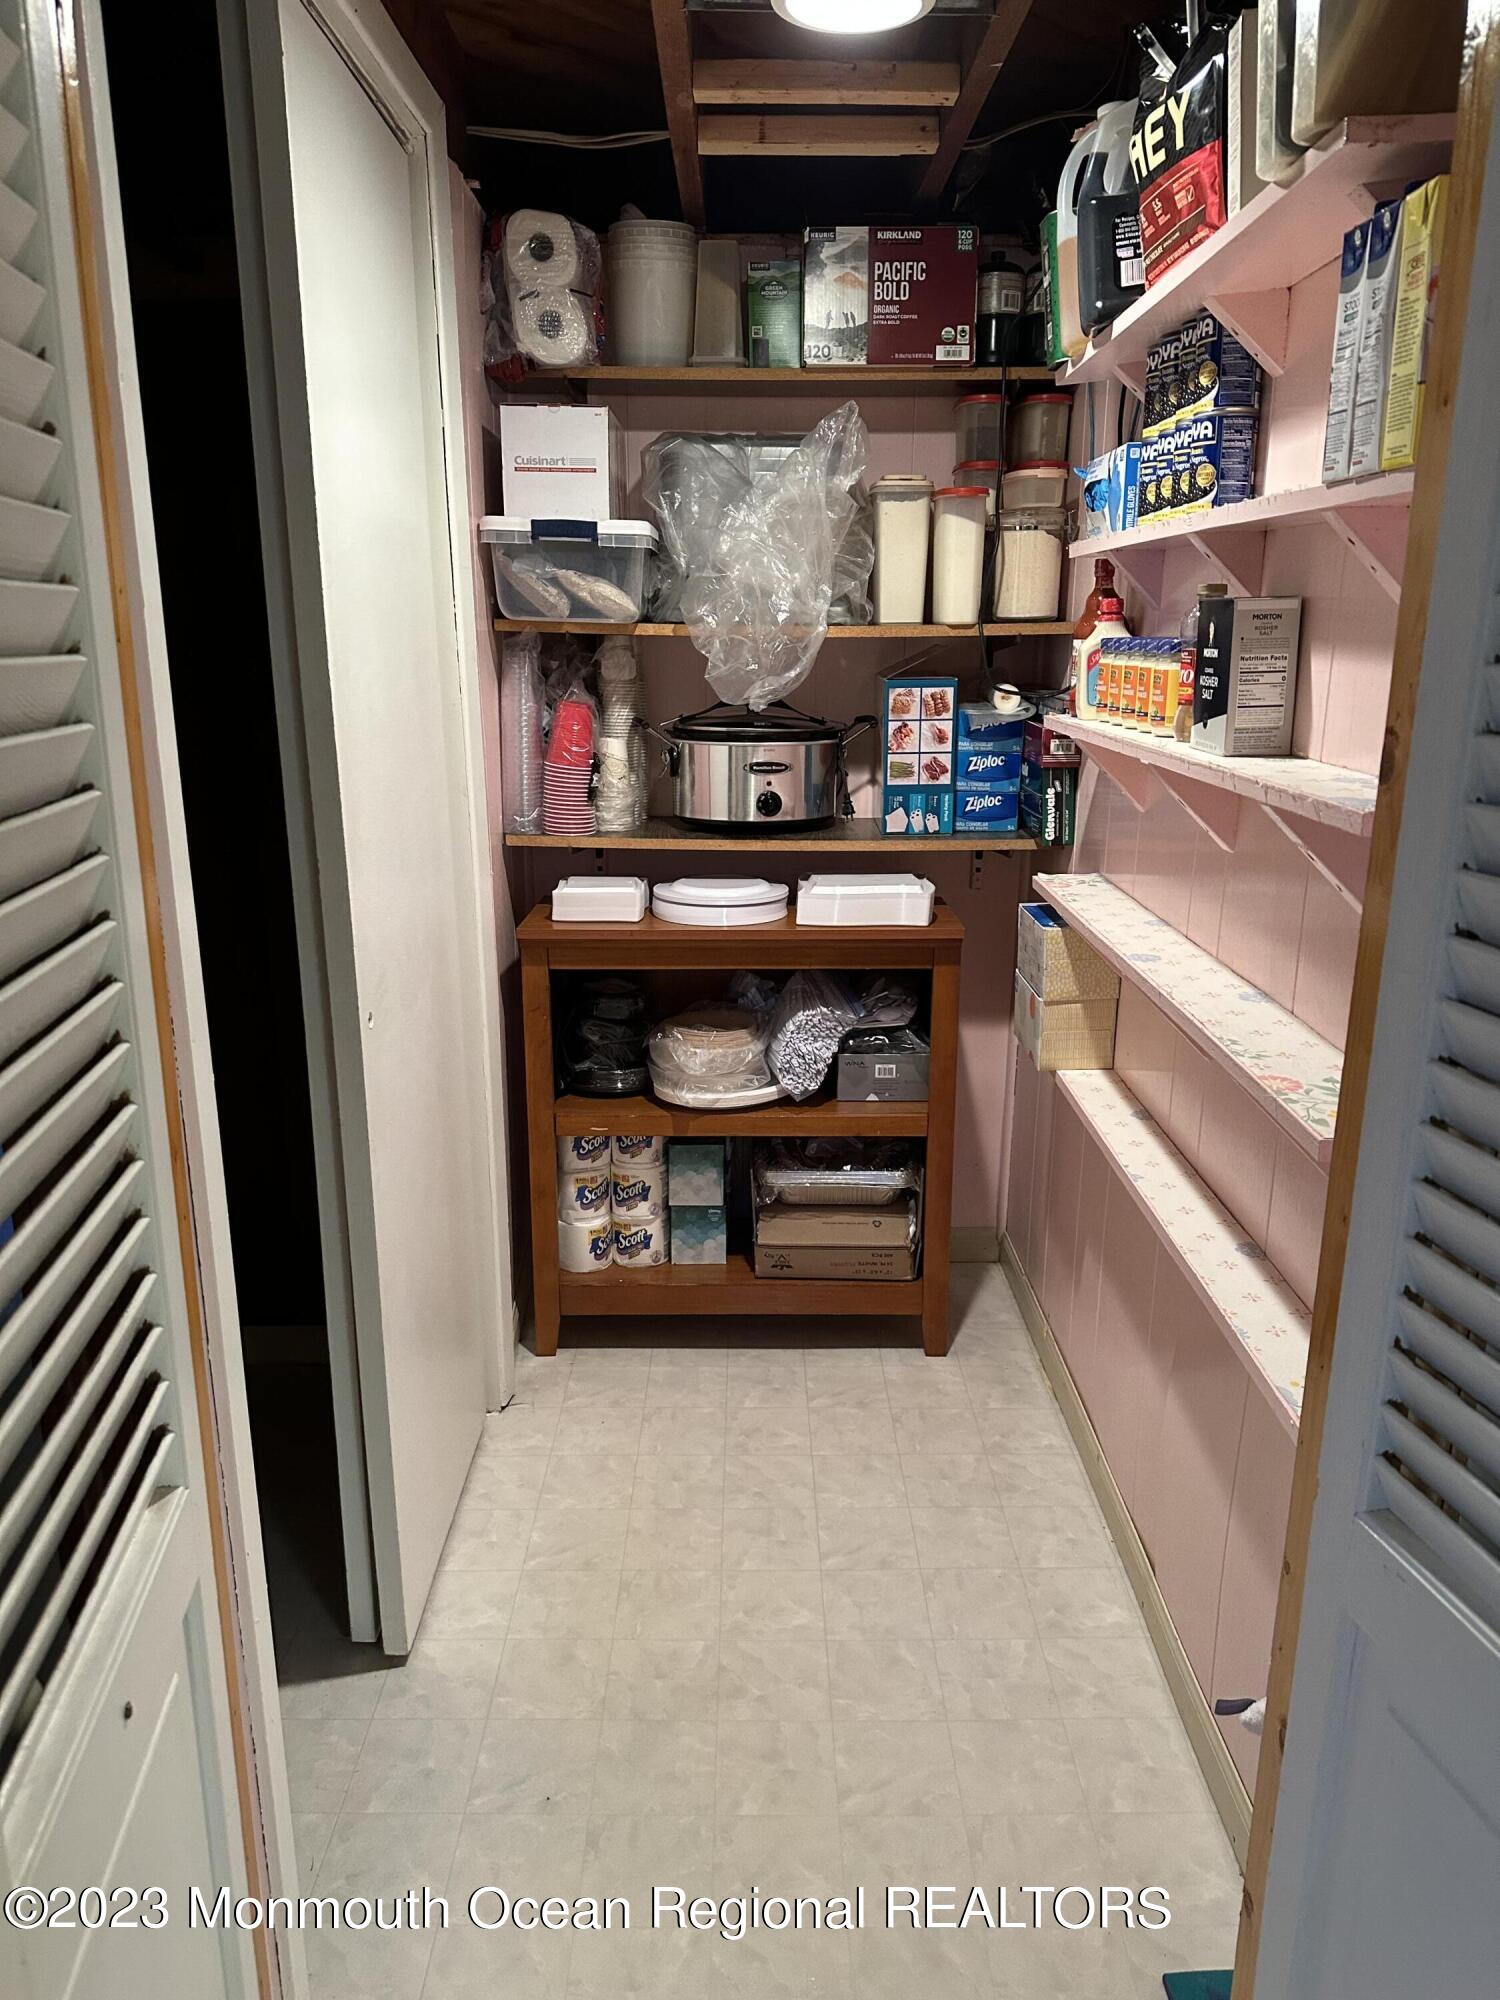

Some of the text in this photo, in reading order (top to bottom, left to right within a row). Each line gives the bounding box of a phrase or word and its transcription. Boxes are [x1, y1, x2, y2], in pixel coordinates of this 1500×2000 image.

[877, 231, 922, 239] KIRKLAND
[958, 230, 973, 239] 120
[874, 262, 927, 280] PACIFIC
[874, 282, 910, 300] BOLD
[873, 305, 900, 313] ORGANIC
[807, 345, 831, 359] 120
[514, 456, 566, 466] Cuisinart
[1127, 485, 1136, 508] GLOVES
[1200, 676, 1218, 687] KOSHER
[1202, 689, 1214, 700] SALT
[968, 755, 1006, 772] Ziploc
[965, 795, 1002, 812] Ziploc
[1045, 787, 1056, 841] Glenvale
[583, 1179, 607, 1203] Scott
[616, 1181, 644, 1200] Scott
[618, 1229, 646, 1248] Scott
